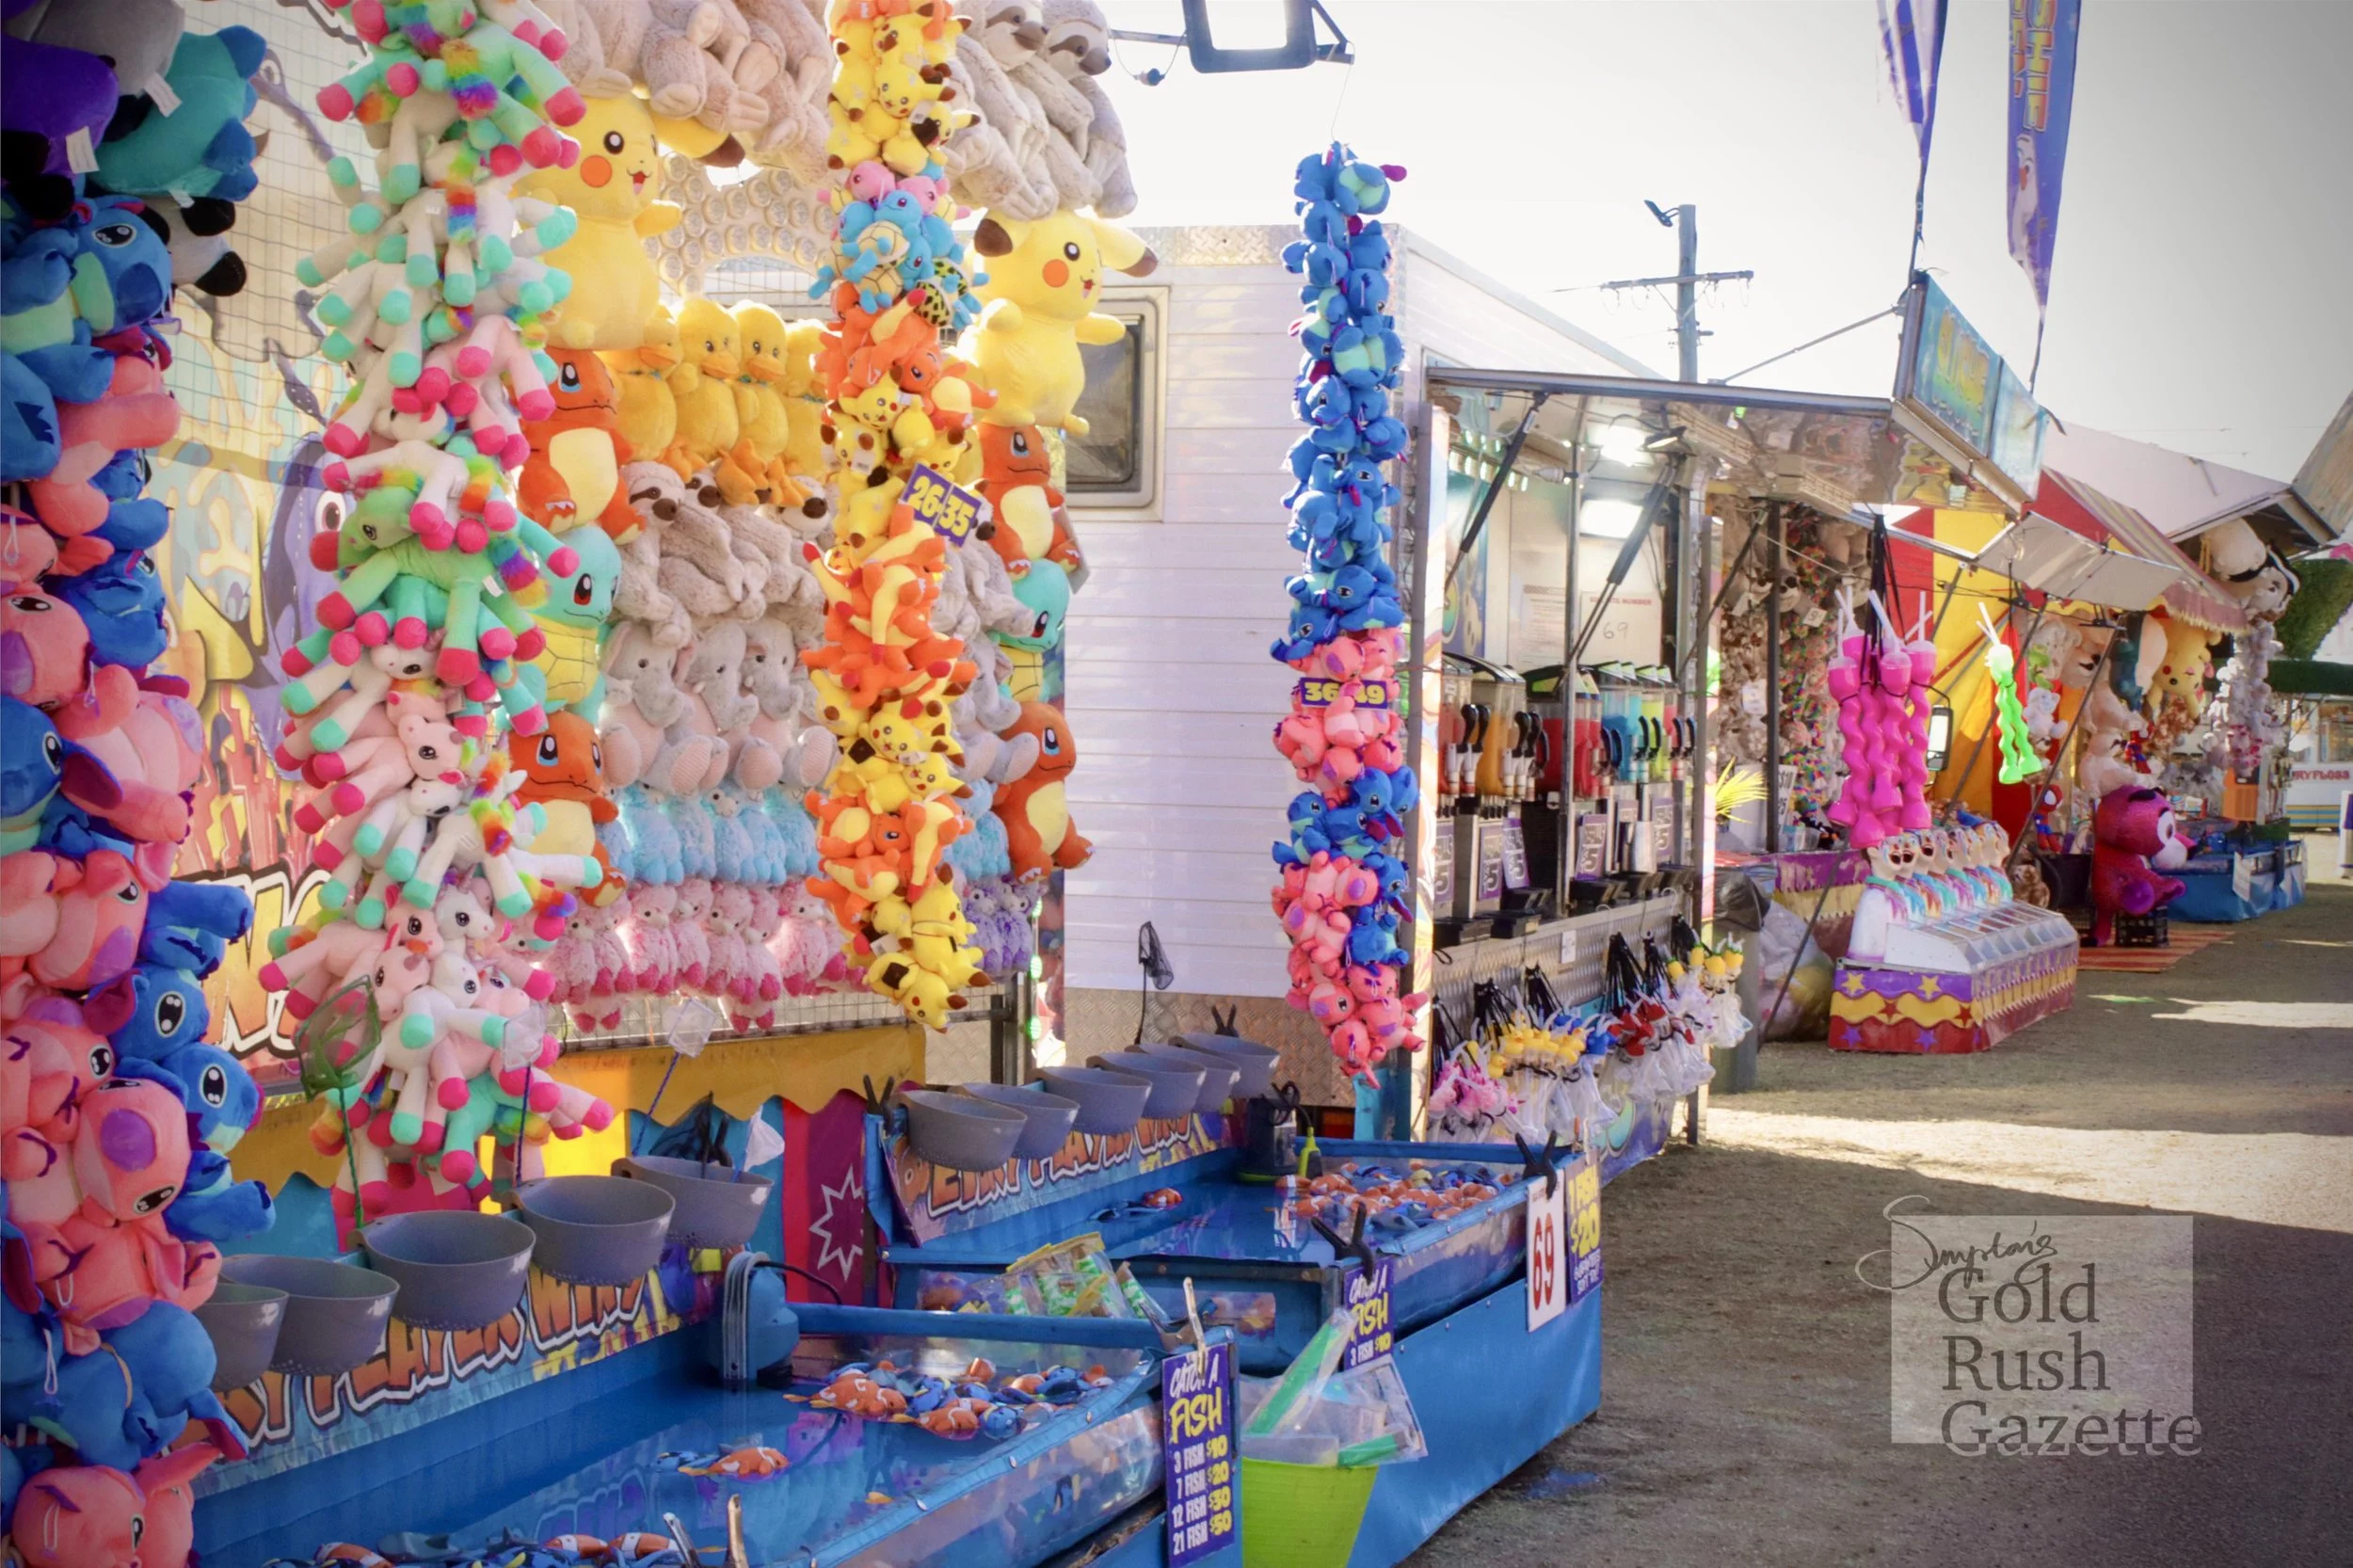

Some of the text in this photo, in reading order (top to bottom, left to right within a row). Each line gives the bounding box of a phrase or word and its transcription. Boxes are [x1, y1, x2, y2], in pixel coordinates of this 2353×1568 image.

[1602, 621, 1629, 640] 69
[1569, 1202, 1601, 1258] $20
[1378, 1264, 1388, 1294] A
[1532, 1212, 1555, 1310] 69
[1208, 1353, 1220, 1389] A
[1357, 1339, 1374, 1364] FISH
[1169, 1386, 1223, 1444] FISH
[1174, 1434, 1228, 1474] 3 FISH $10
[1184, 1469, 1207, 1496] FISH
[1207, 1461, 1230, 1485] $20
[1171, 1485, 1232, 1529] 12 FISH $30
[1172, 1510, 1233, 1557] 21 FISH $50
